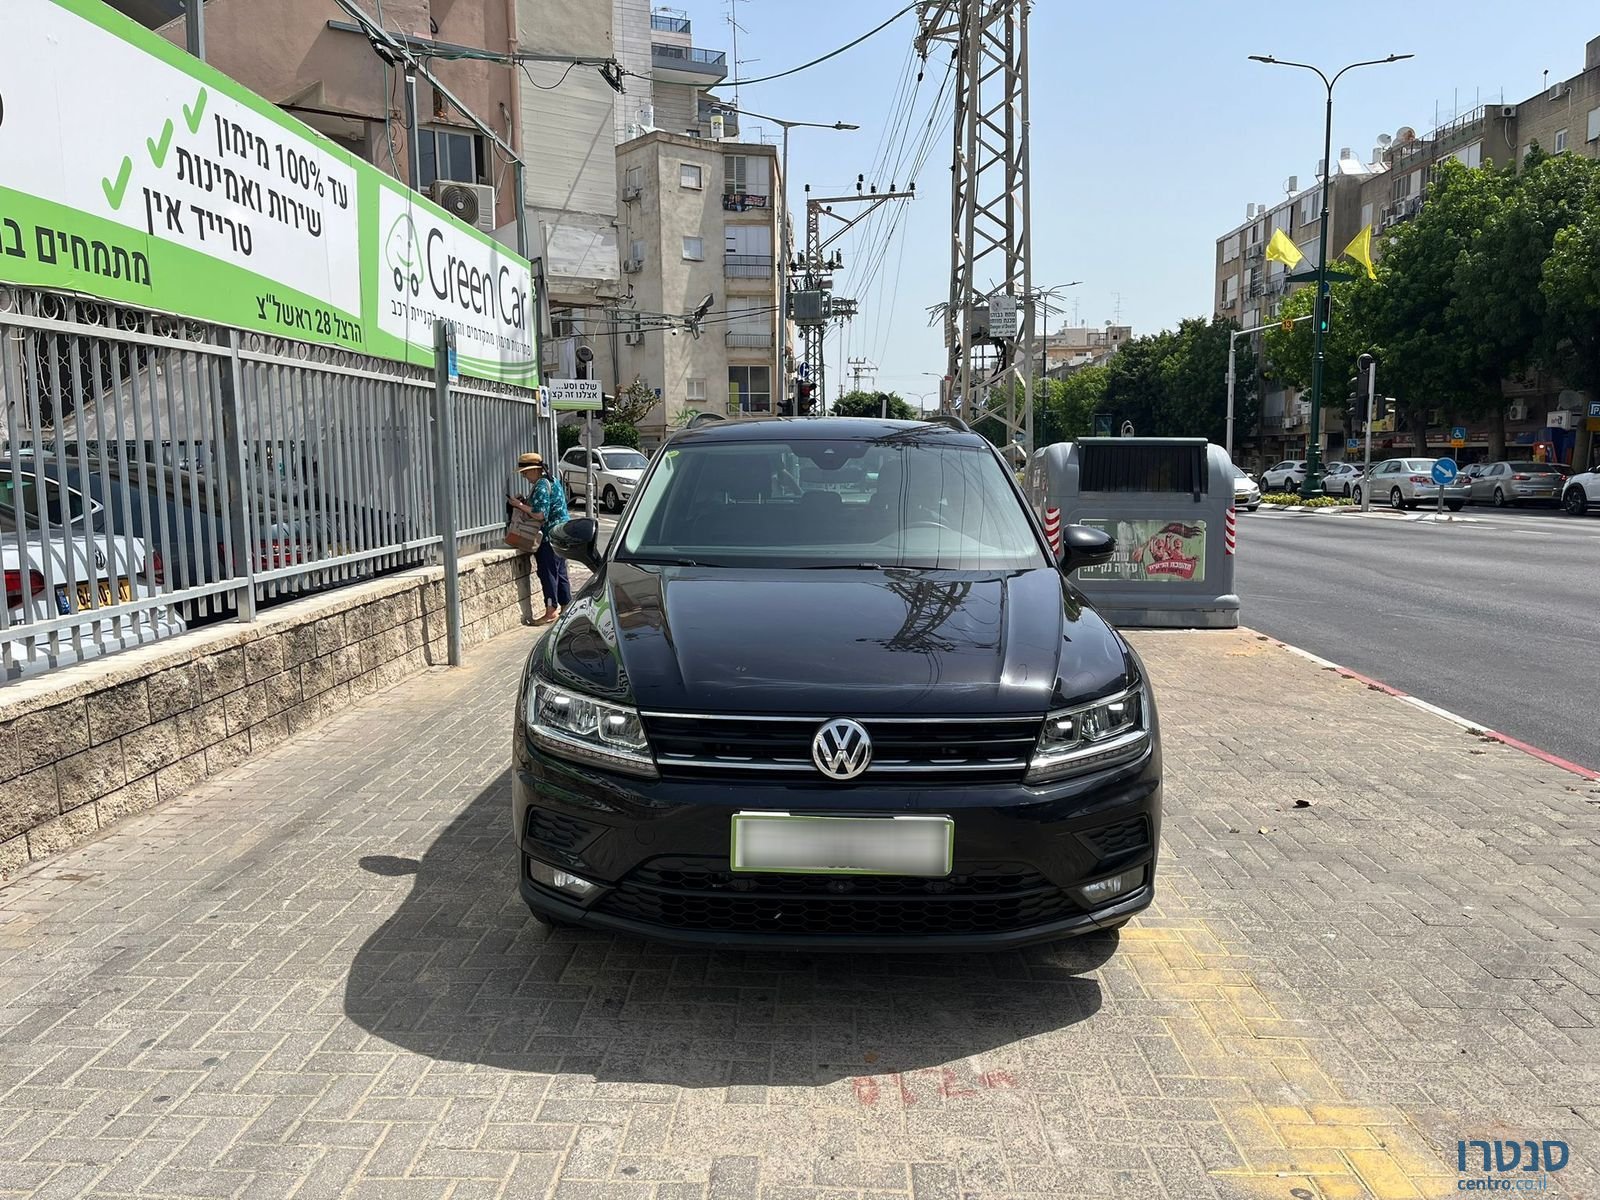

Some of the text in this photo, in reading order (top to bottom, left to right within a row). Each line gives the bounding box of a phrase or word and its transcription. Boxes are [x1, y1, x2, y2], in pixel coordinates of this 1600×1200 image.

[214, 112, 348, 210] עד 100% מימון
[176, 146, 322, 237] שירות ואמינות
[142, 186, 253, 256] טרייד אין
[35, 225, 151, 286] מתמחים
[427, 227, 527, 331] Green Car
[314, 308, 332, 336] 28
[391, 299, 409, 319] רכב
[333, 312, 362, 344] הרצל
[466, 325, 495, 347] מתקדמים
[576, 390, 598, 399] אצלנו
[580, 382, 598, 391] שלם
